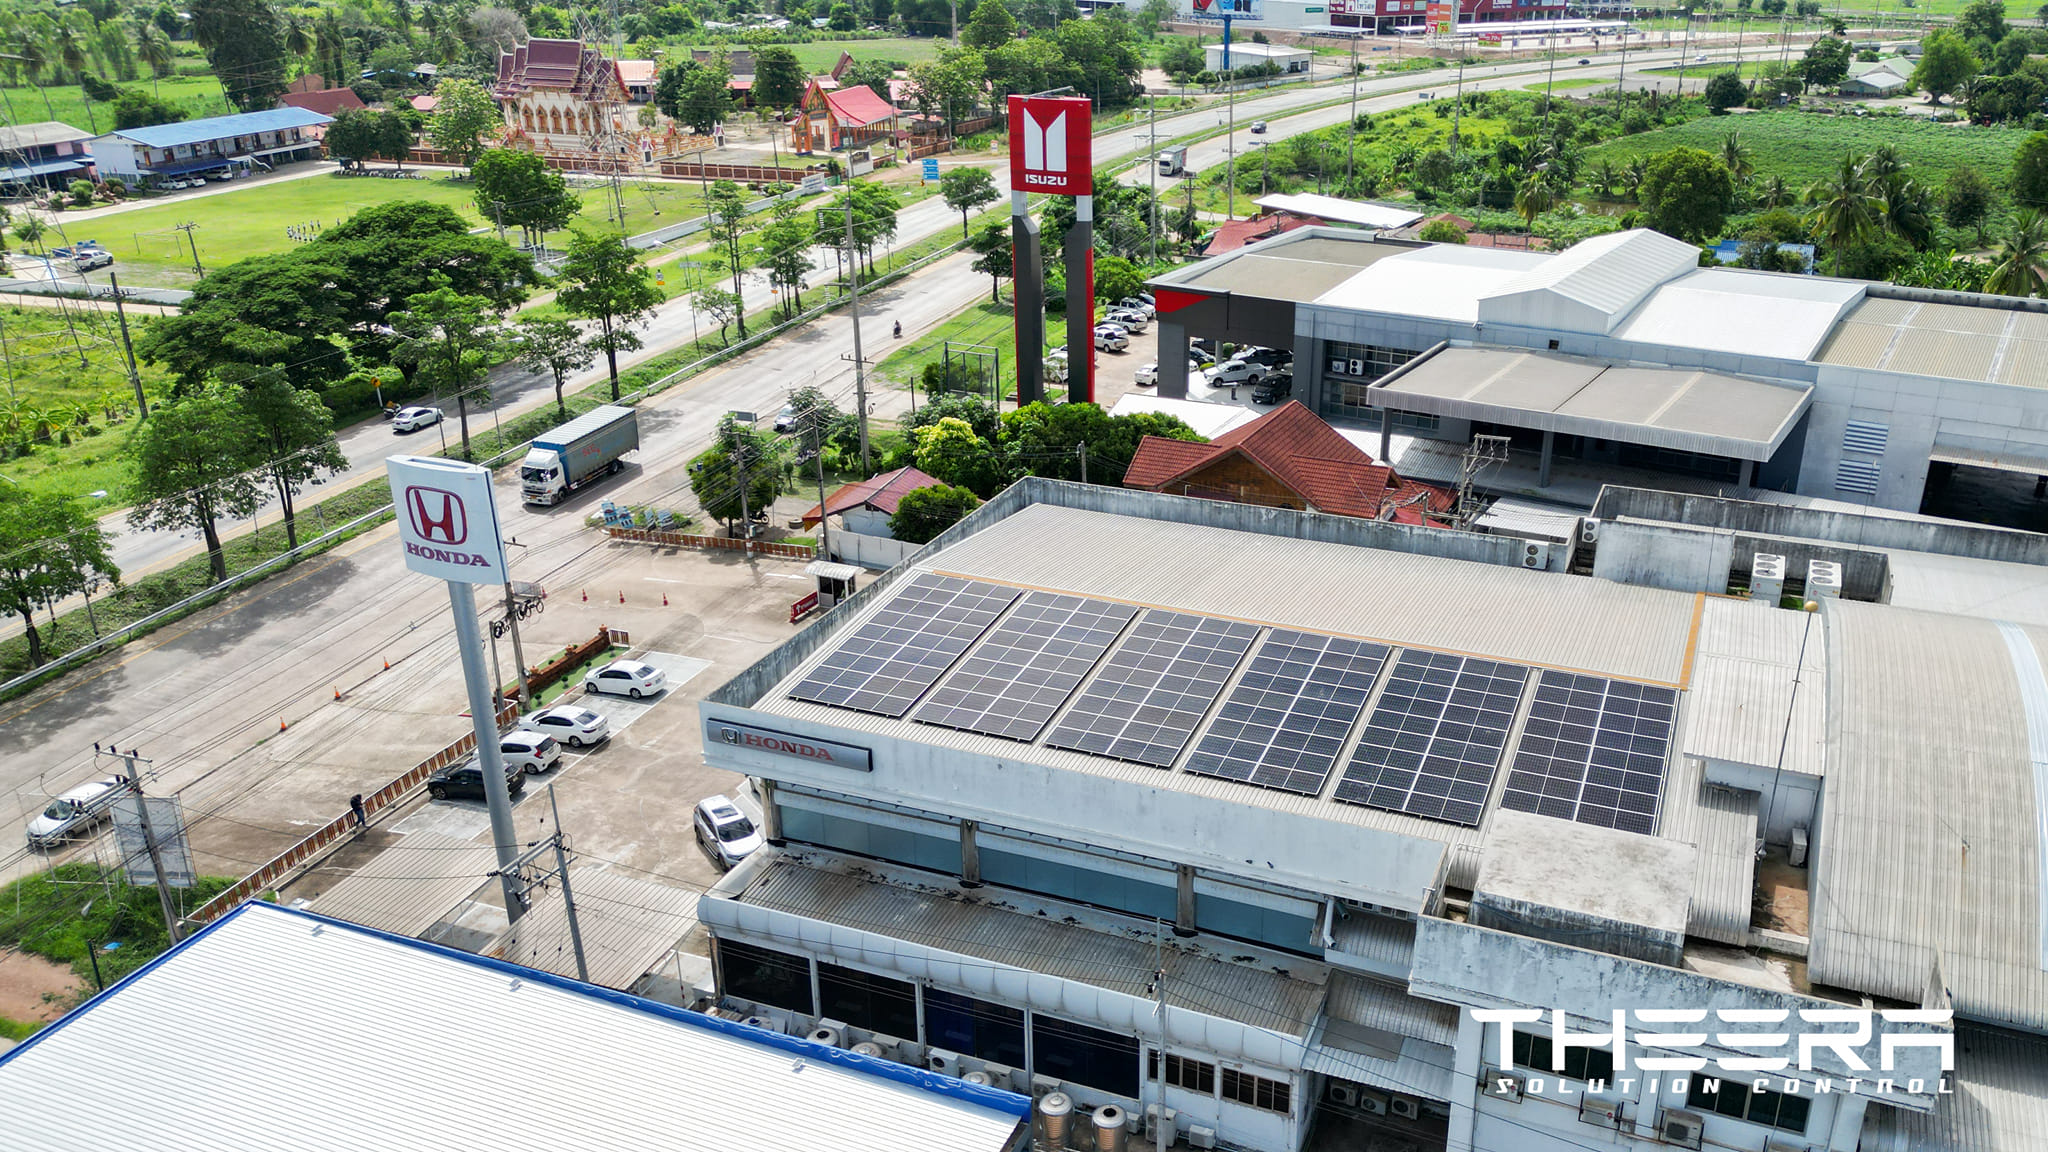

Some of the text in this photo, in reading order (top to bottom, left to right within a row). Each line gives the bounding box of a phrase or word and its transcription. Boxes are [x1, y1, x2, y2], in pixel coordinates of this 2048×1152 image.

[1025, 174, 1067, 186] ISUZU
[405, 541, 491, 567] HONDA
[743, 733, 834, 761] HONDA
